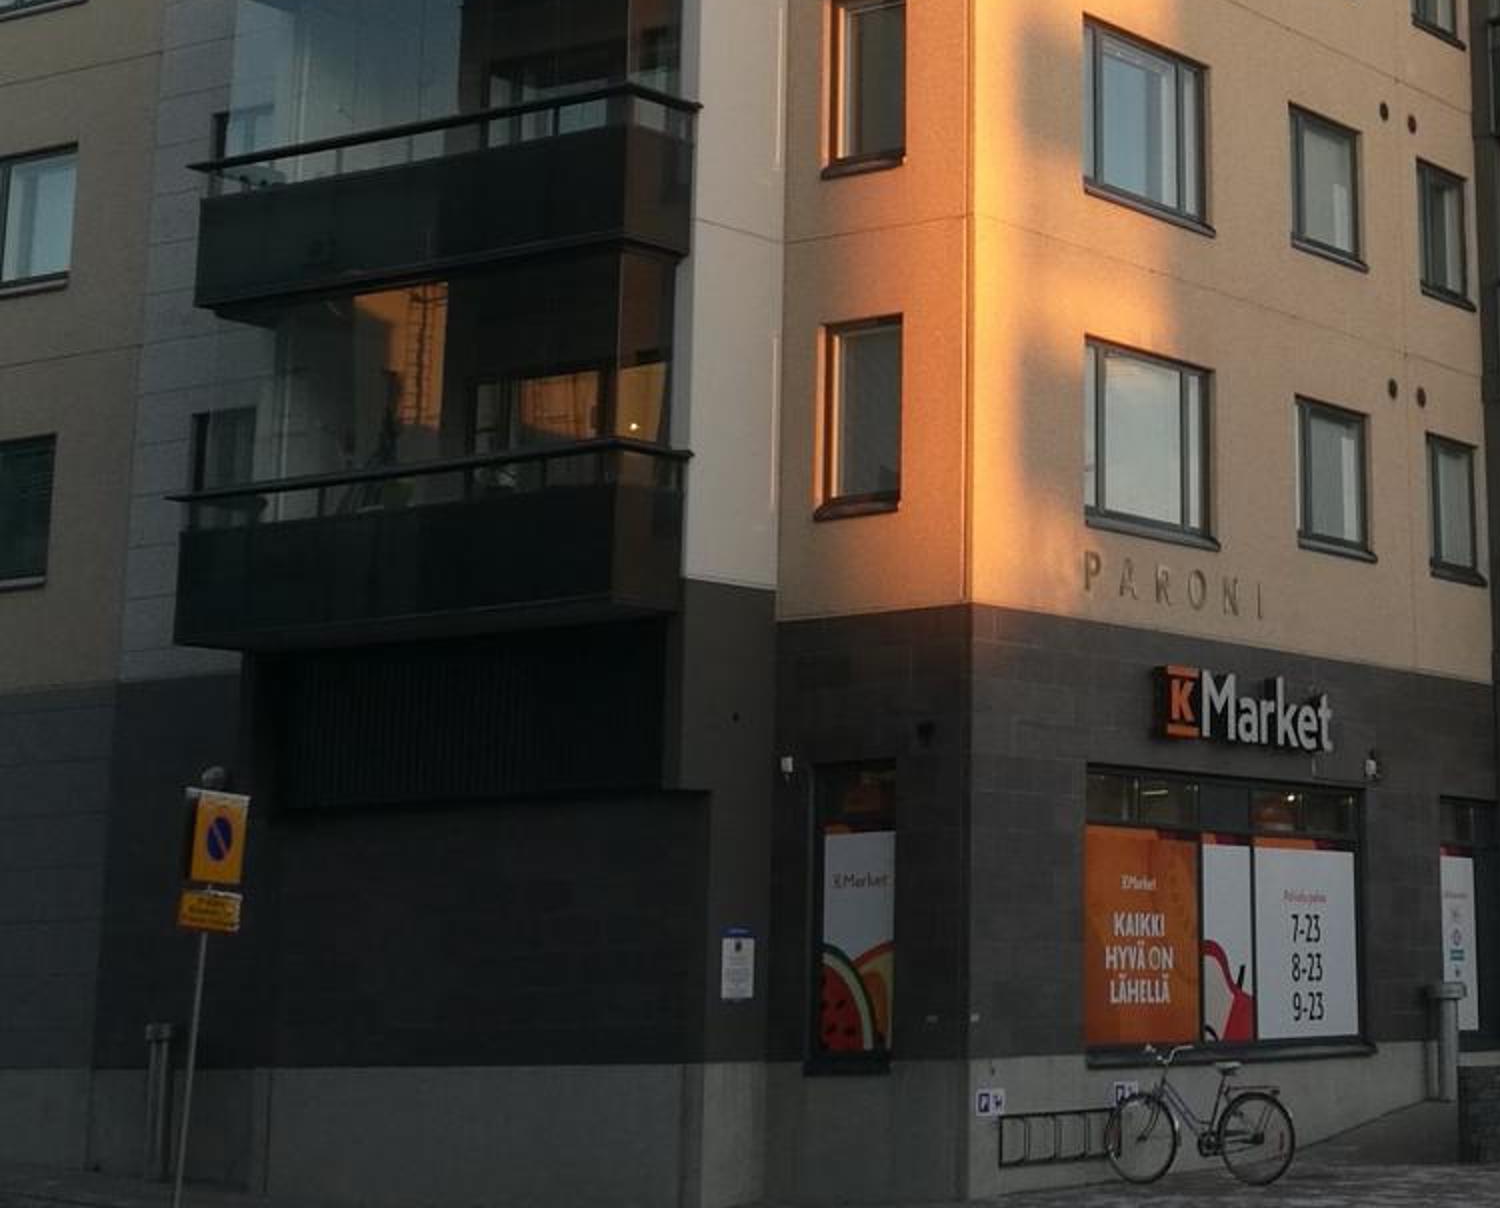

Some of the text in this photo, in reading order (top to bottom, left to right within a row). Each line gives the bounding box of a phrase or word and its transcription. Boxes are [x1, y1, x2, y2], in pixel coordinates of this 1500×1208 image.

[1084, 550, 1263, 620] PARONI
[1201, 669, 1333, 752] Market
[1113, 912, 1165, 937] KAIKKI
[1291, 914, 1321, 943] 7-23
[1105, 940, 1174, 970] HYVÄ ON
[1291, 953, 1323, 982] 8-23
[1110, 973, 1171, 1005] LÄHELLÄ
[1293, 992, 1324, 1022] 9-23
